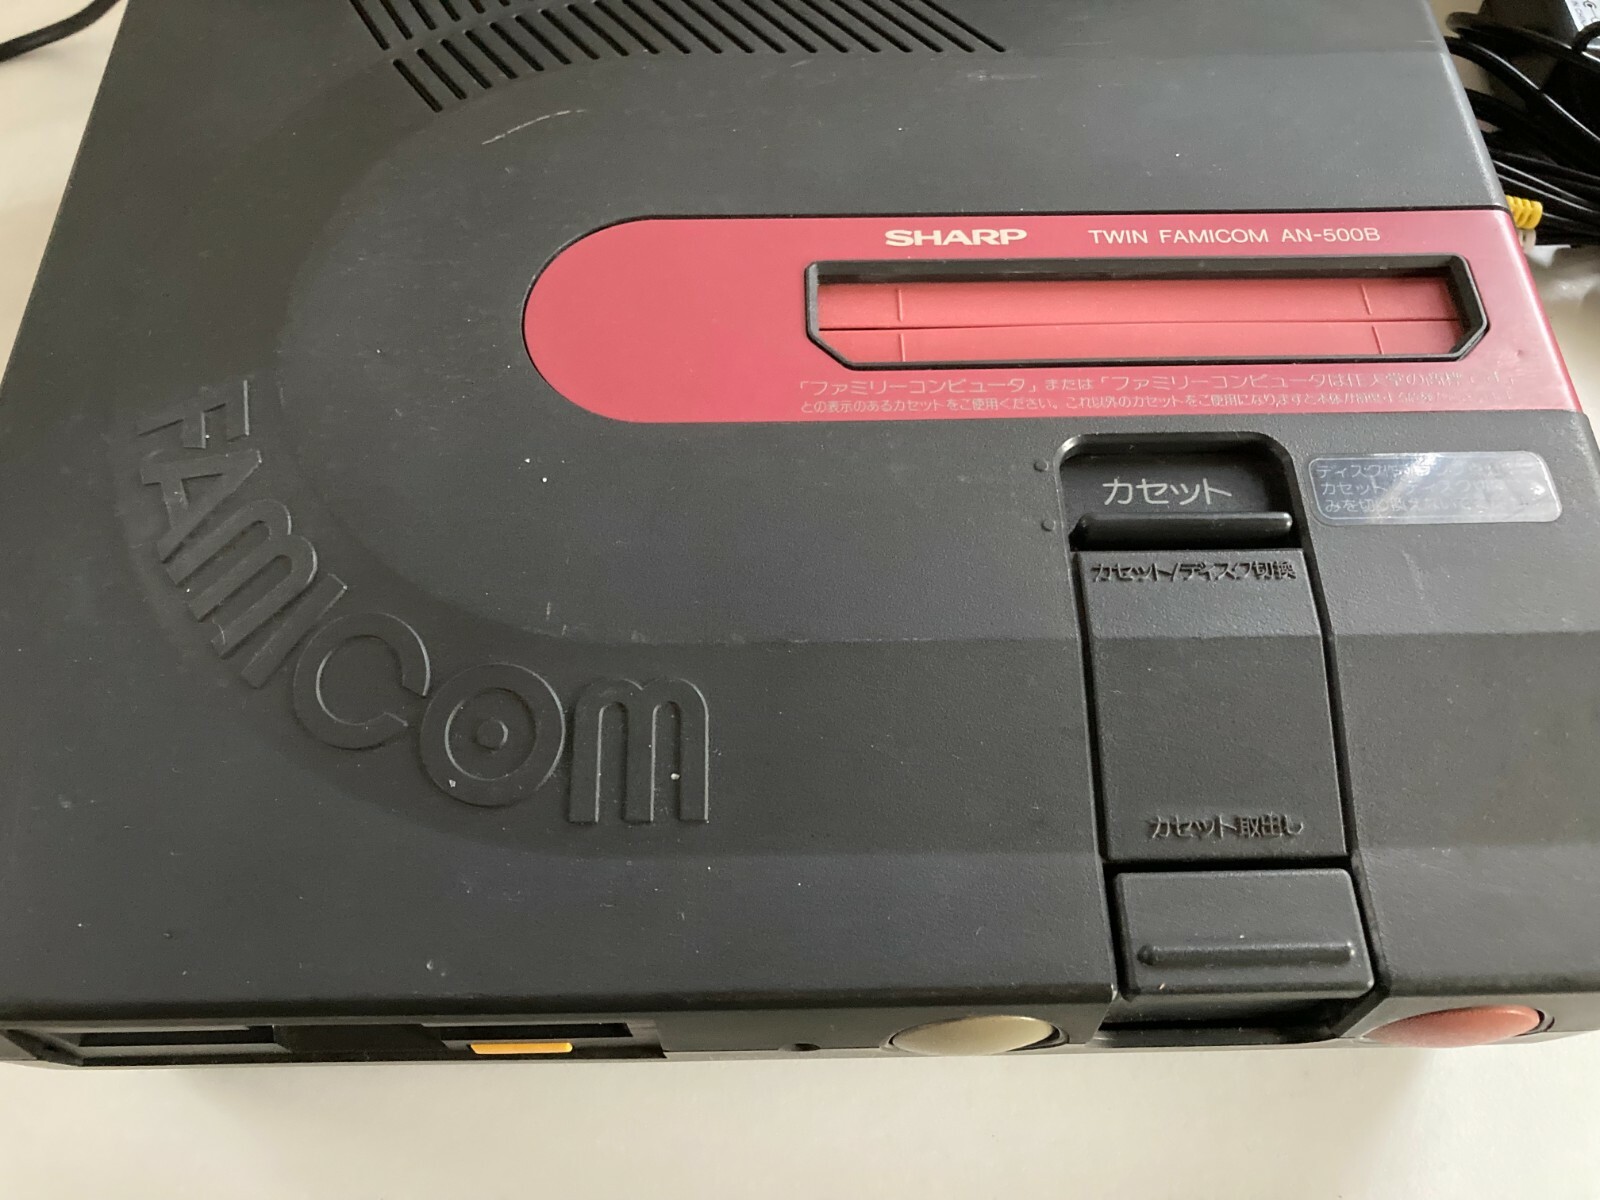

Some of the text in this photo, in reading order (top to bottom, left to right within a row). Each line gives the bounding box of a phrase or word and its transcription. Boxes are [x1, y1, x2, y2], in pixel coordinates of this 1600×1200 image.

[884, 228, 1028, 248] SHARP
[1087, 226, 1382, 245] TWIN FAMICOM AN-500B
[1101, 476, 1233, 506] カセット
[1148, 810, 1305, 840] カセット取出し
